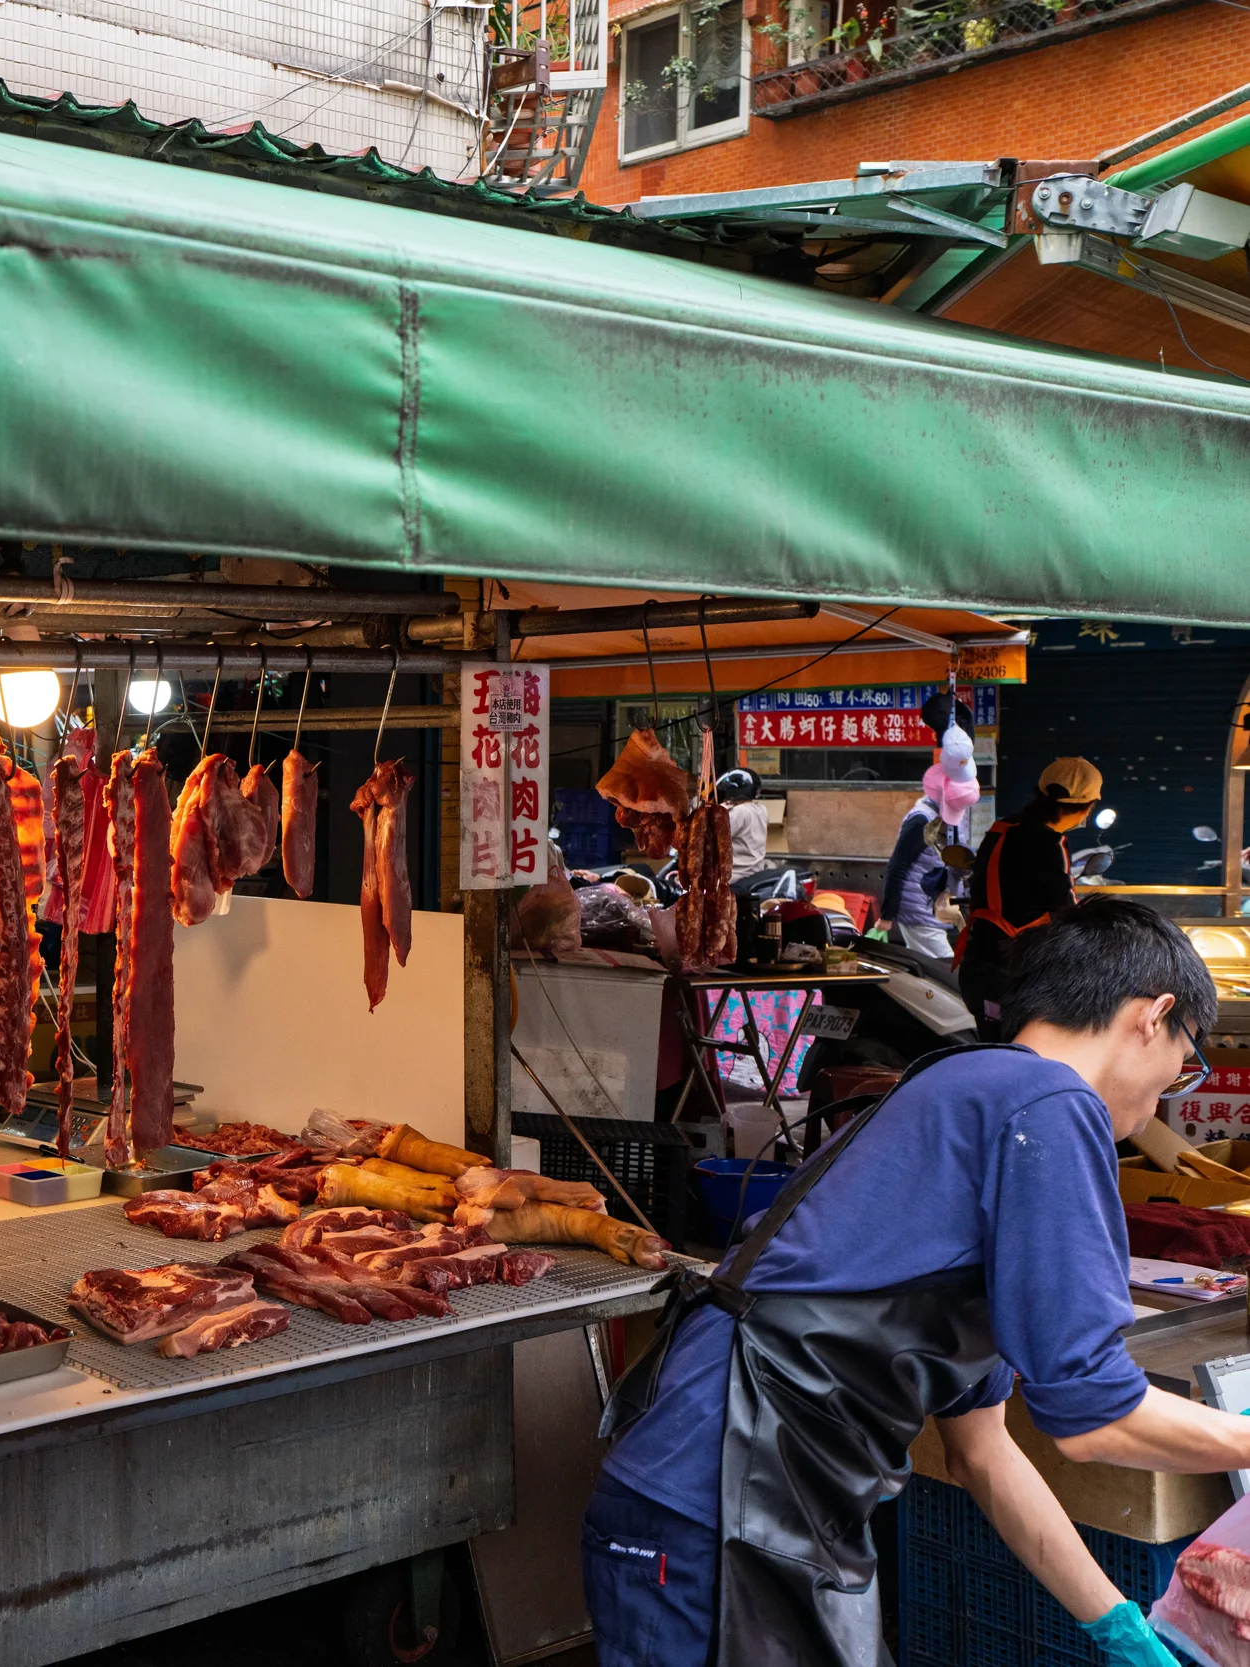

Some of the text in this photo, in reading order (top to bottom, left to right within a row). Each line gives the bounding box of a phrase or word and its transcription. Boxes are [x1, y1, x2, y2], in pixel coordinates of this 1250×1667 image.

[492, 698, 521, 710] 本店使用
[804, 1012, 854, 1033] PAX-9073
